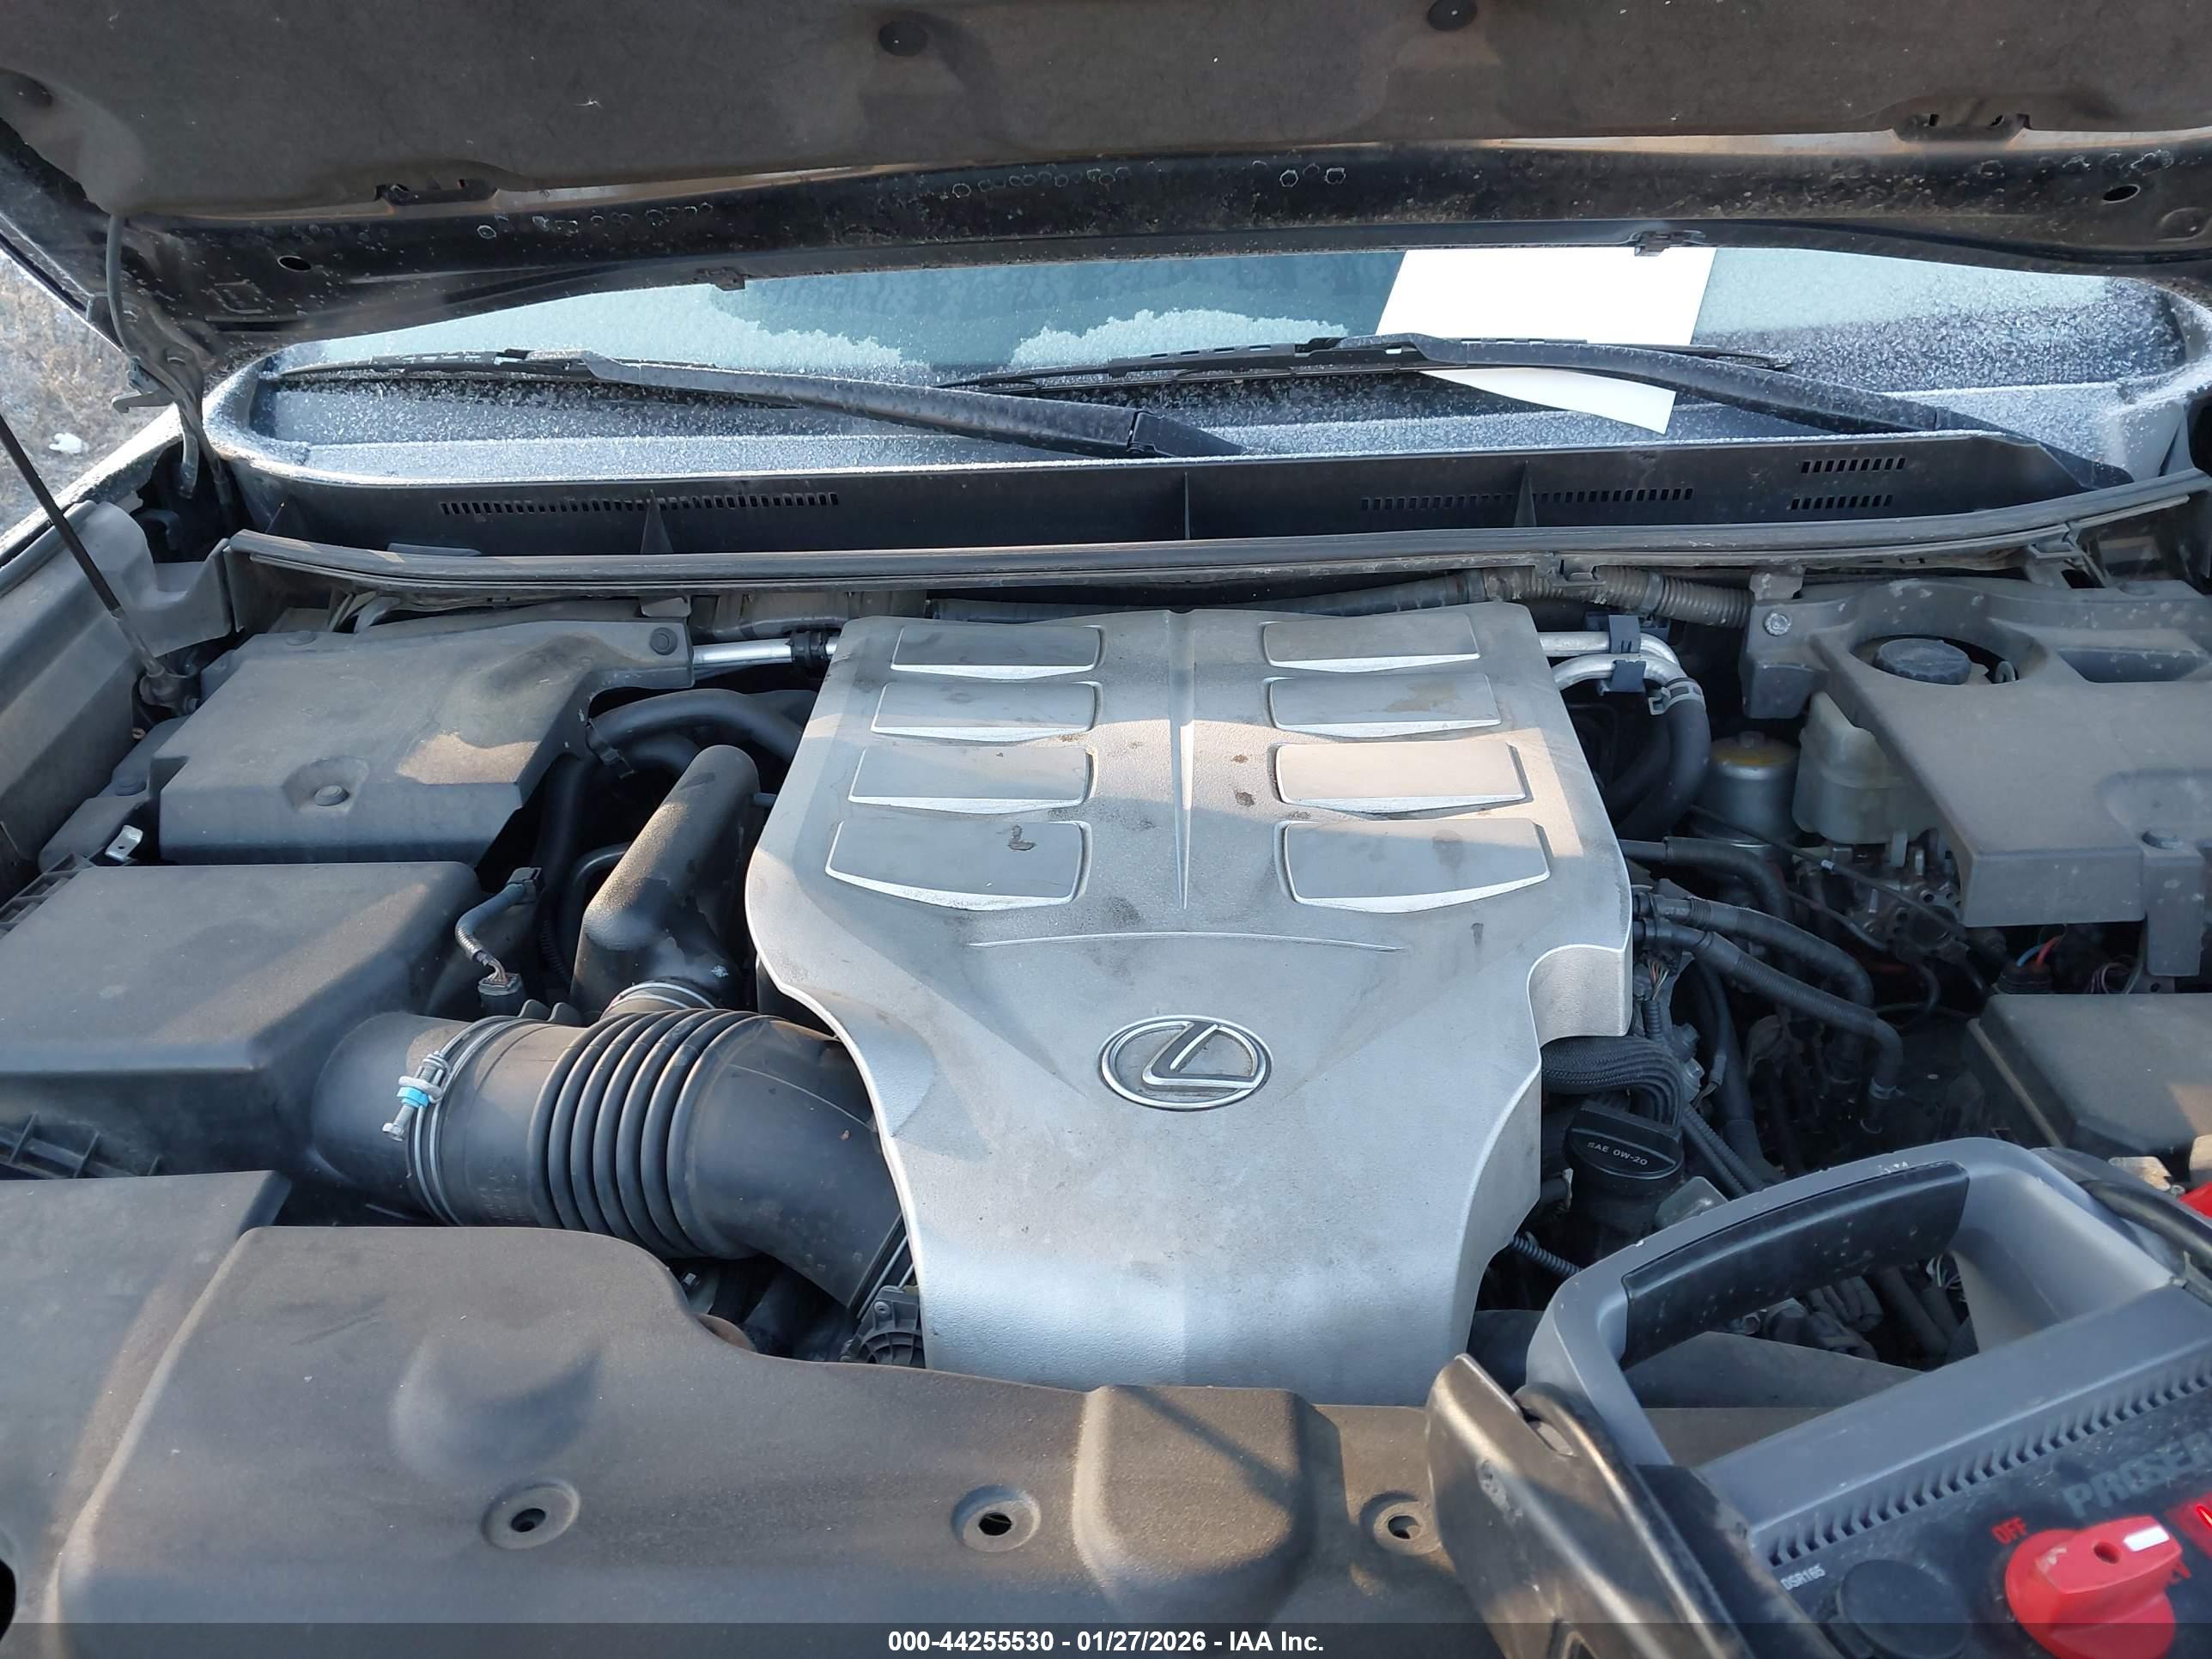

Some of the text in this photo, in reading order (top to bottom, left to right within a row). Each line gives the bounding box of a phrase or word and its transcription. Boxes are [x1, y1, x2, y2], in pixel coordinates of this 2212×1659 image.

[1613, 1149, 1648, 1165] 0W-20
[1991, 1516, 2027, 1545] OFF
[1780, 1563, 1826, 1590] DSR165
